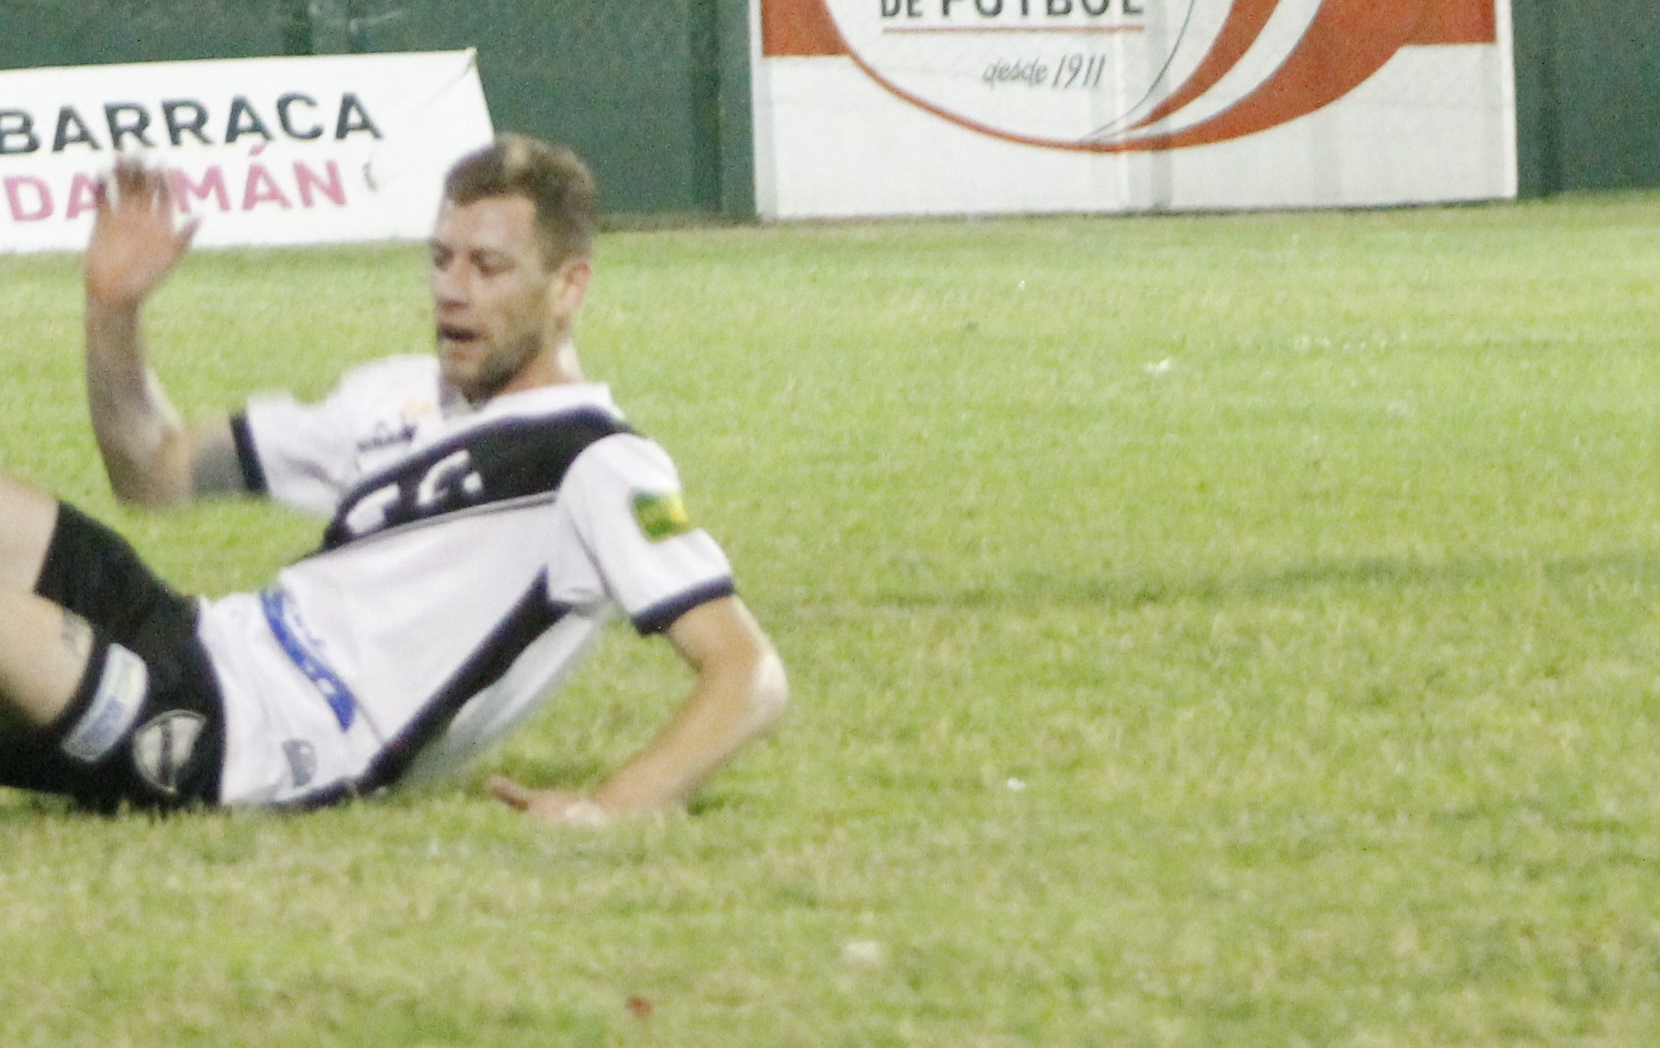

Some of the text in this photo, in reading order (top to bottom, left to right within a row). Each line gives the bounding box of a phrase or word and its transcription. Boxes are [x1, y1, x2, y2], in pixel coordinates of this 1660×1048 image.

[981, 51, 1106, 90] desde 1911
[3, 142, 348, 223] DAMÁN
